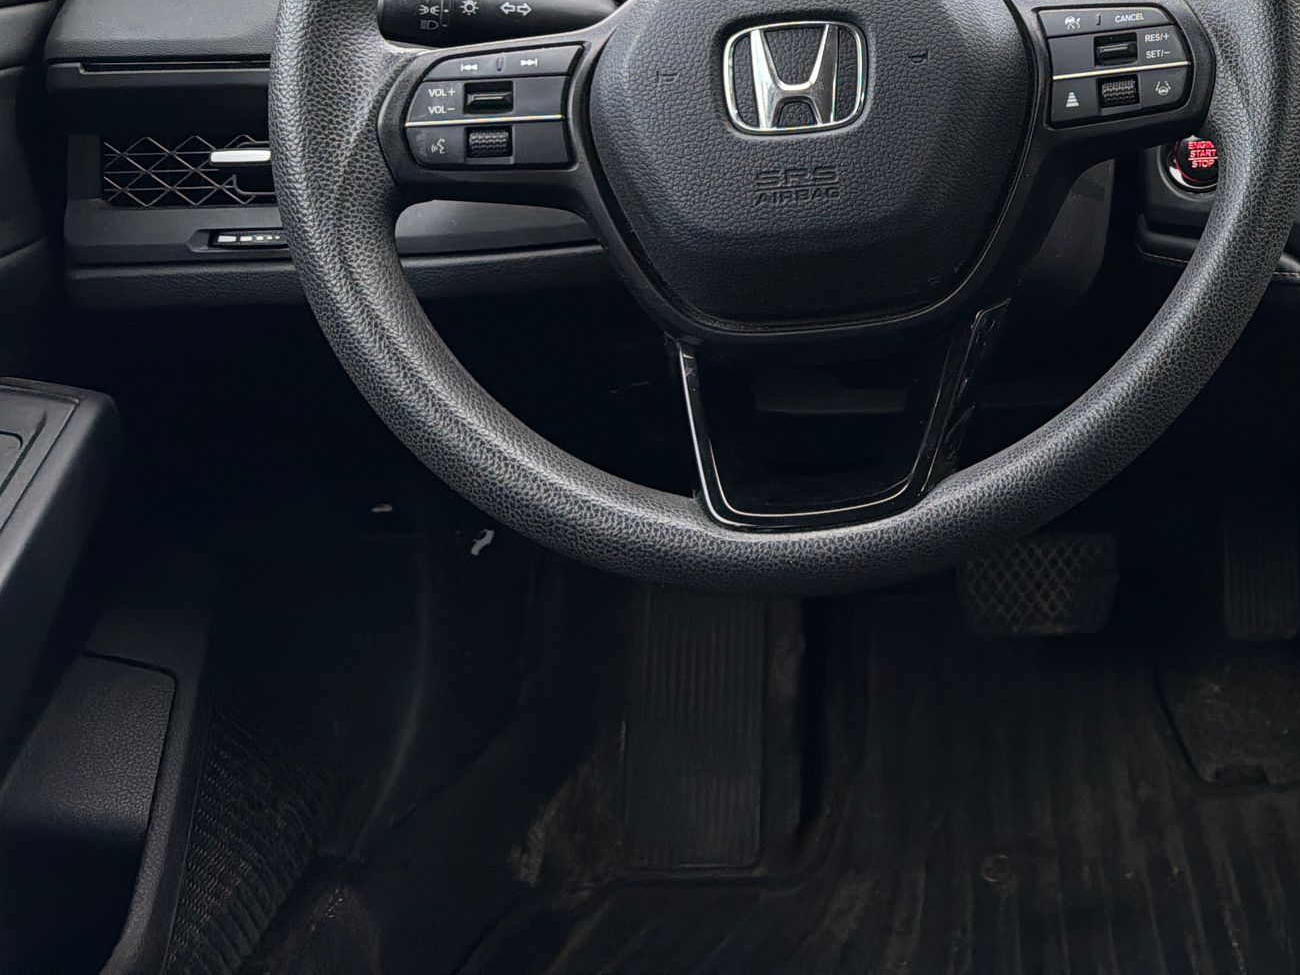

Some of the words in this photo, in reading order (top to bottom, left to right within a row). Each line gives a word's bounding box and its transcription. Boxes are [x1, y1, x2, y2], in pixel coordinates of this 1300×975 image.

[1115, 12, 1145, 24] CANCEL
[1188, 140, 1216, 150] ENGIN
[1190, 148, 1217, 158] START
[1191, 159, 1215, 168] STOP
[755, 166, 839, 187] SRS
